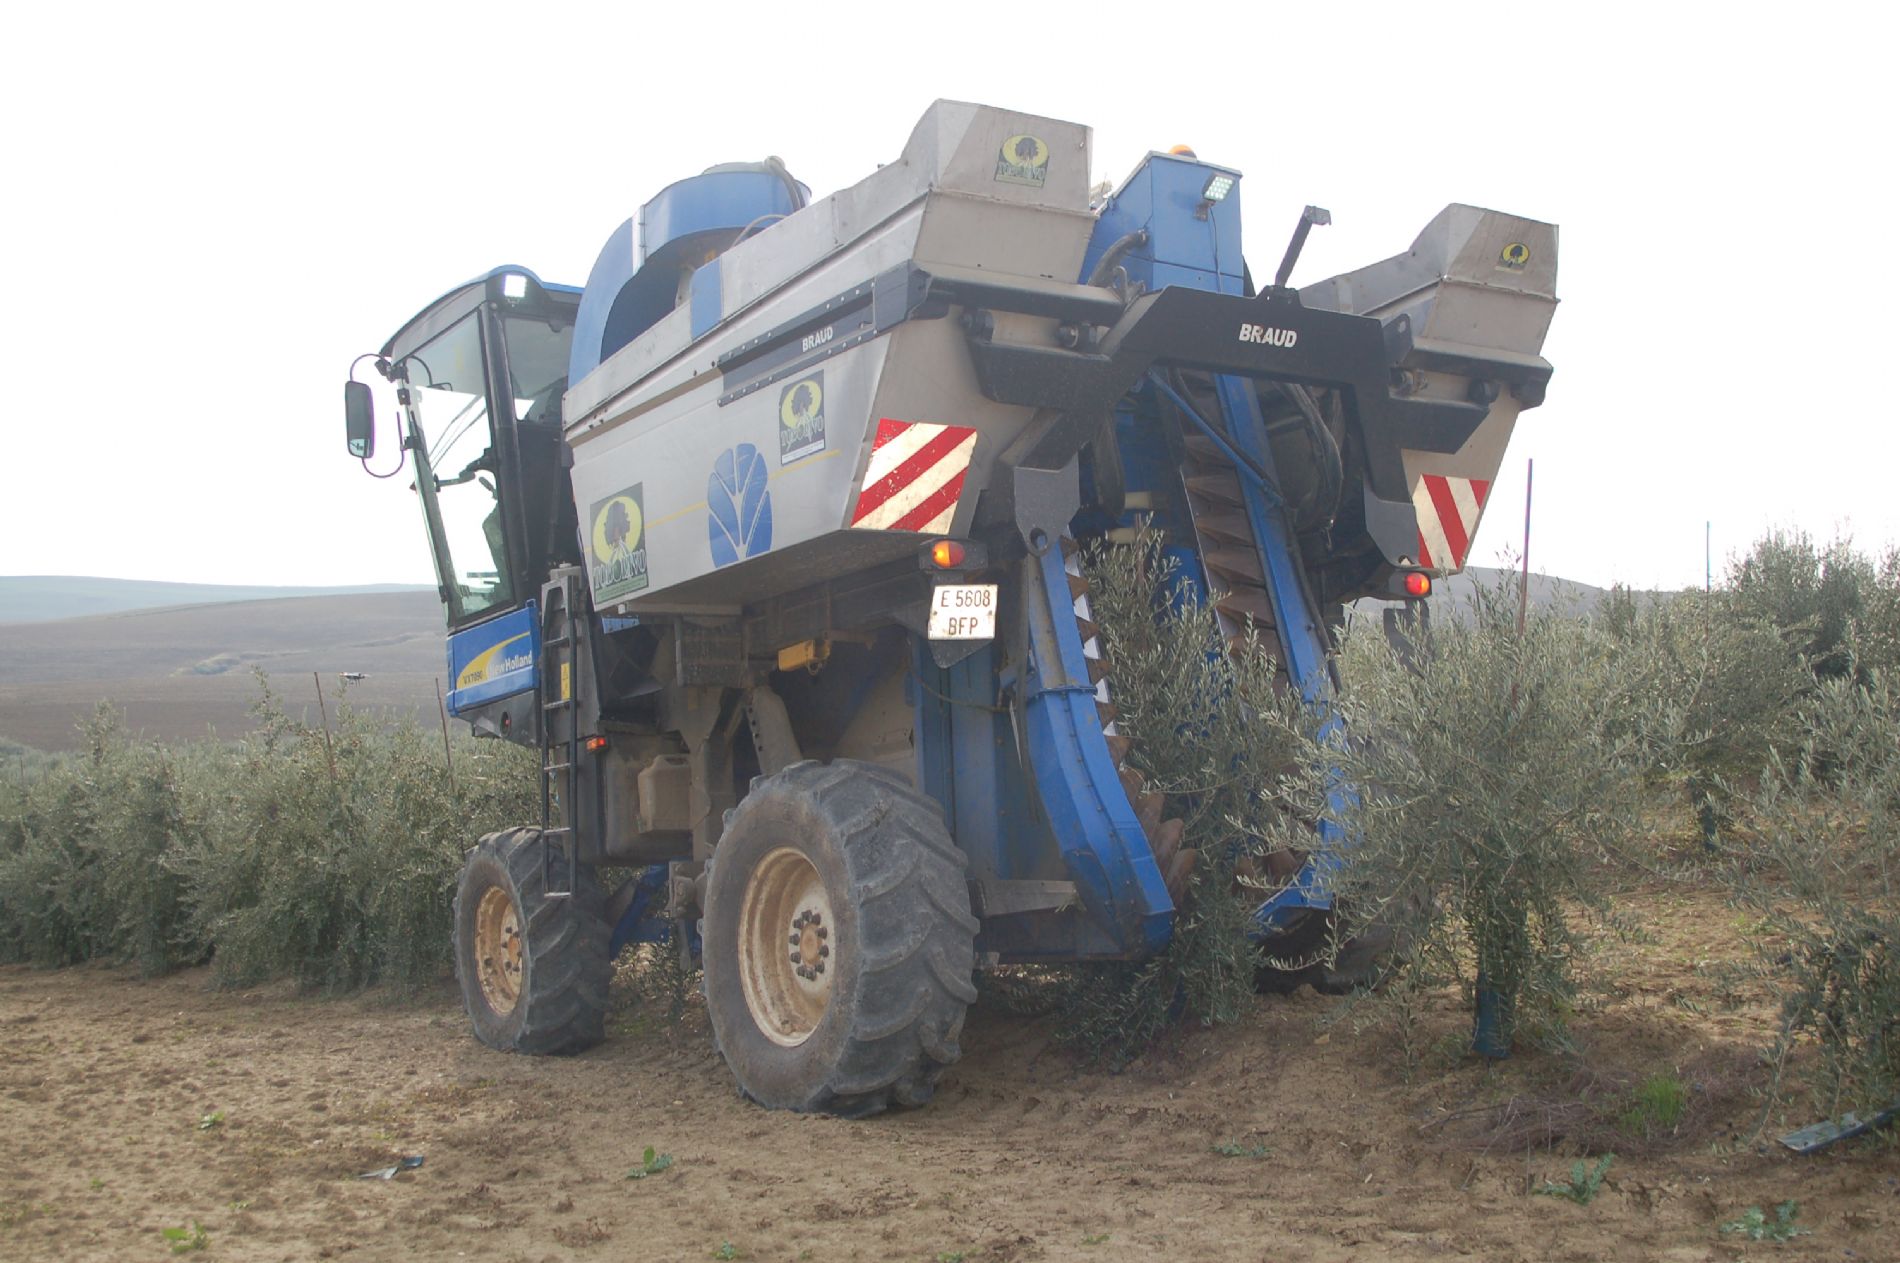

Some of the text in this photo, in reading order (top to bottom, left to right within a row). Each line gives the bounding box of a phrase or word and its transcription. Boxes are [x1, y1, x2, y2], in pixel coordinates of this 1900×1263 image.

[802, 326, 833, 353] BRAUD
[1239, 323, 1297, 348] BRAUD
[941, 589, 991, 608] E 5608
[948, 616, 979, 636] BFP
[504, 650, 533, 673] Holland
